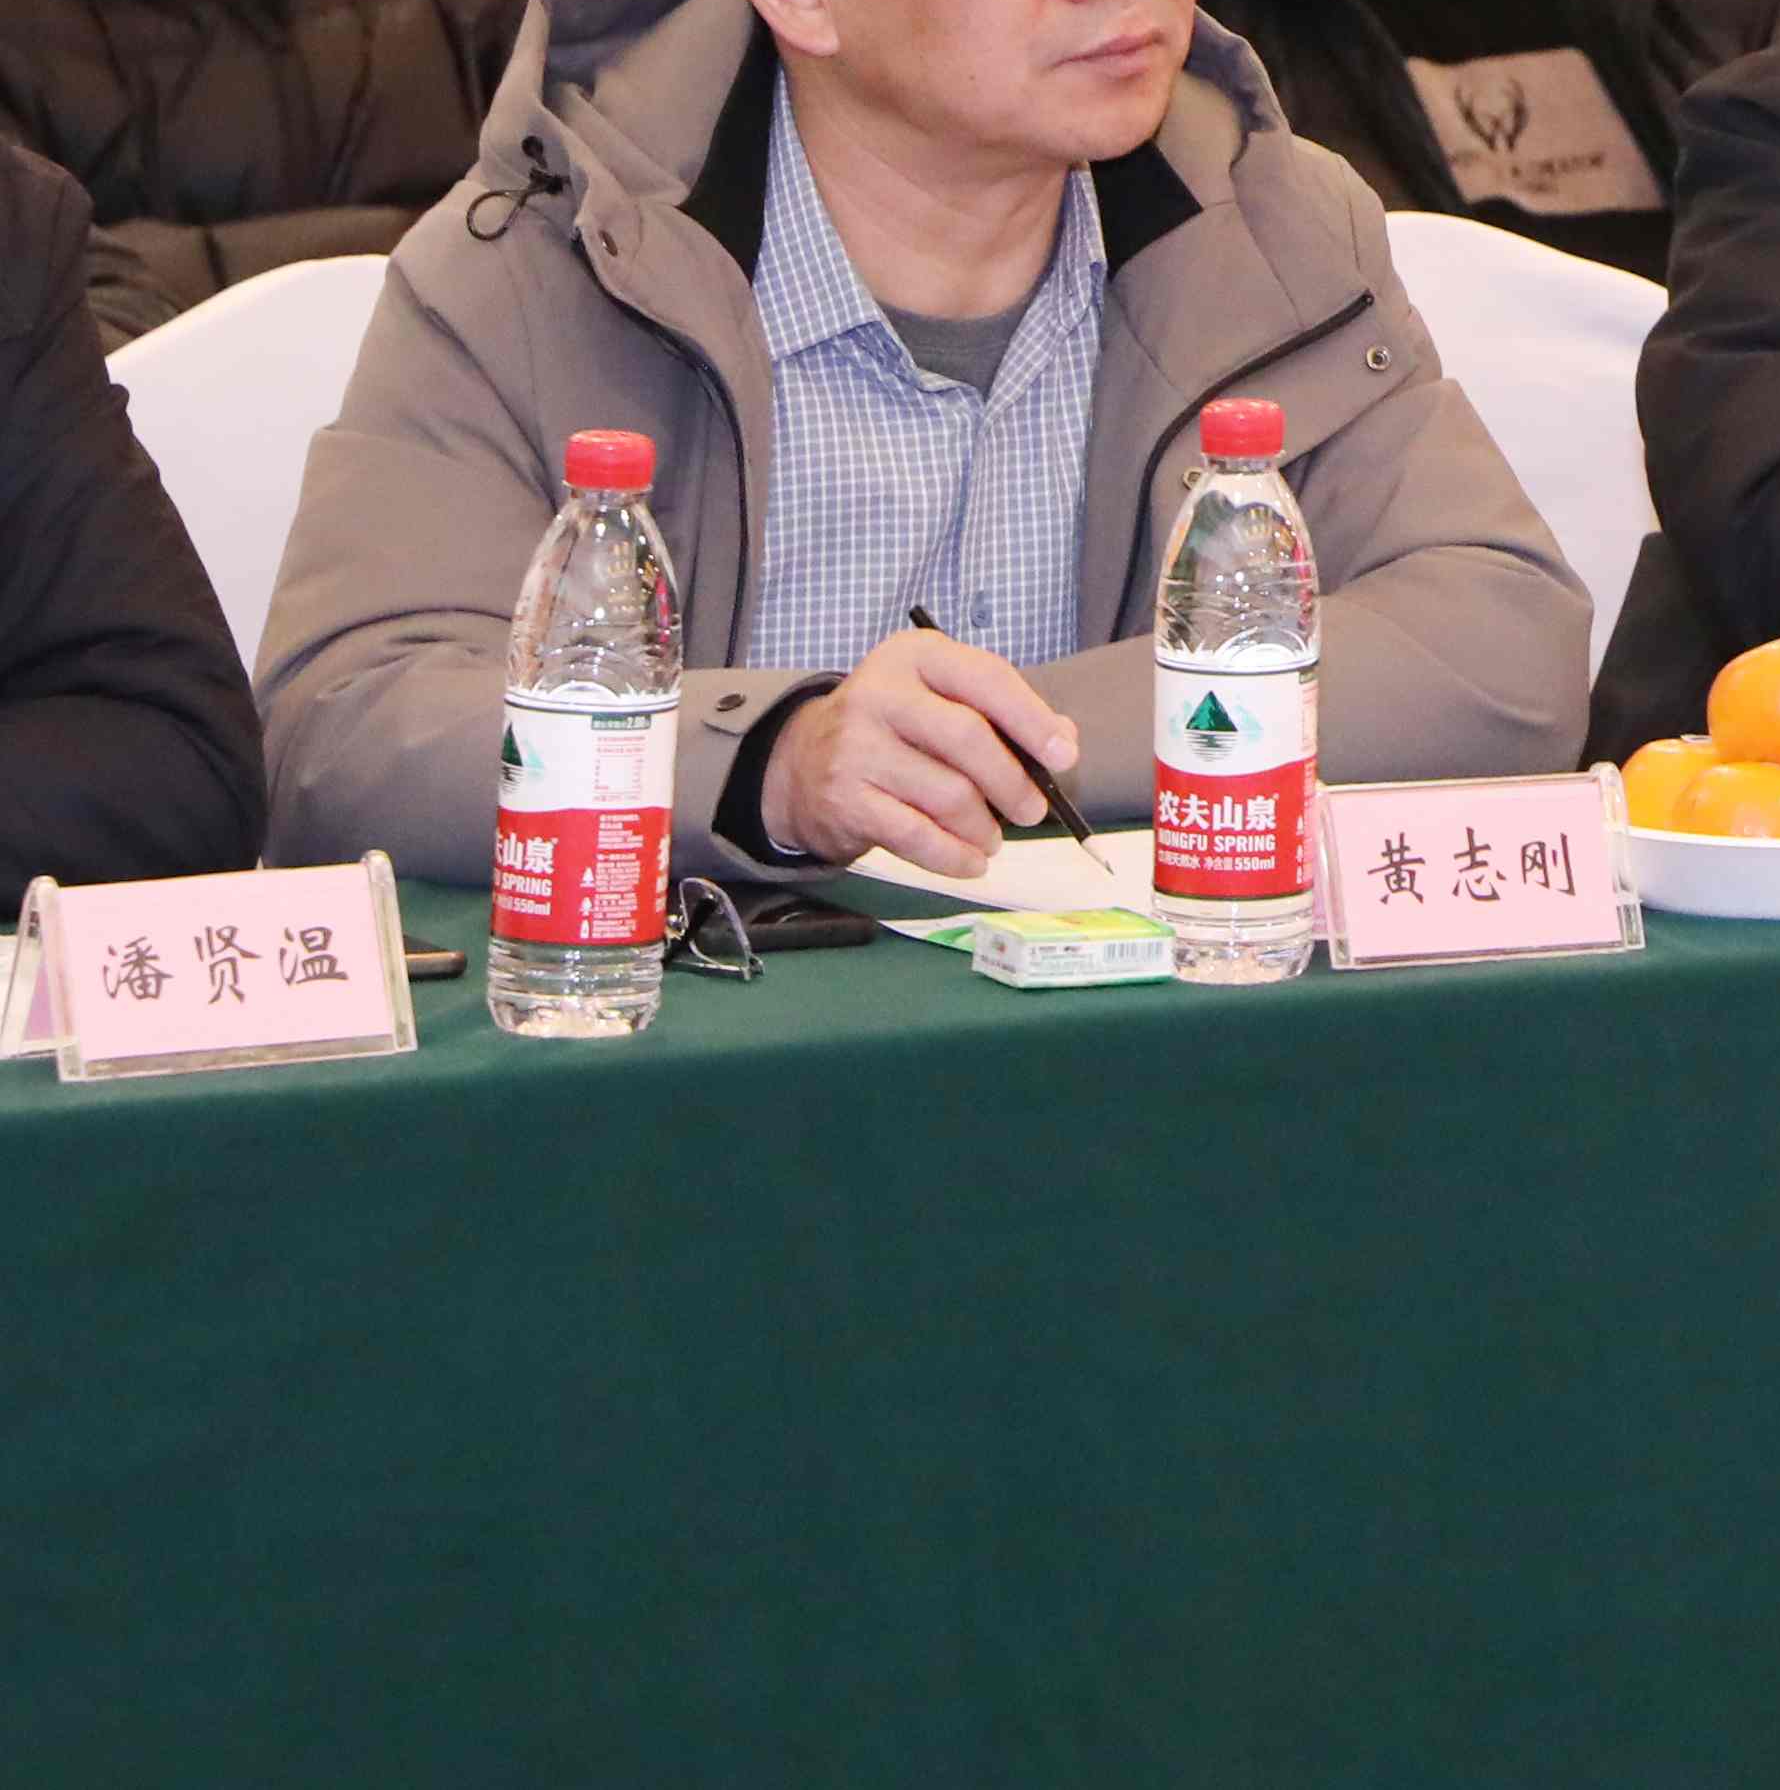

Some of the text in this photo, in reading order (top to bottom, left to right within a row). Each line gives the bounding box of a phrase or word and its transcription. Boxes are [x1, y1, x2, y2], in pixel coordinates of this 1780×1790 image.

[1158, 790, 1277, 832] 农夫山泉
[1213, 833, 1277, 854] SPRING
[502, 871, 553, 898] SPRING
[1366, 825, 1577, 905] 黄志刚
[102, 924, 350, 1005] 潘贤温
